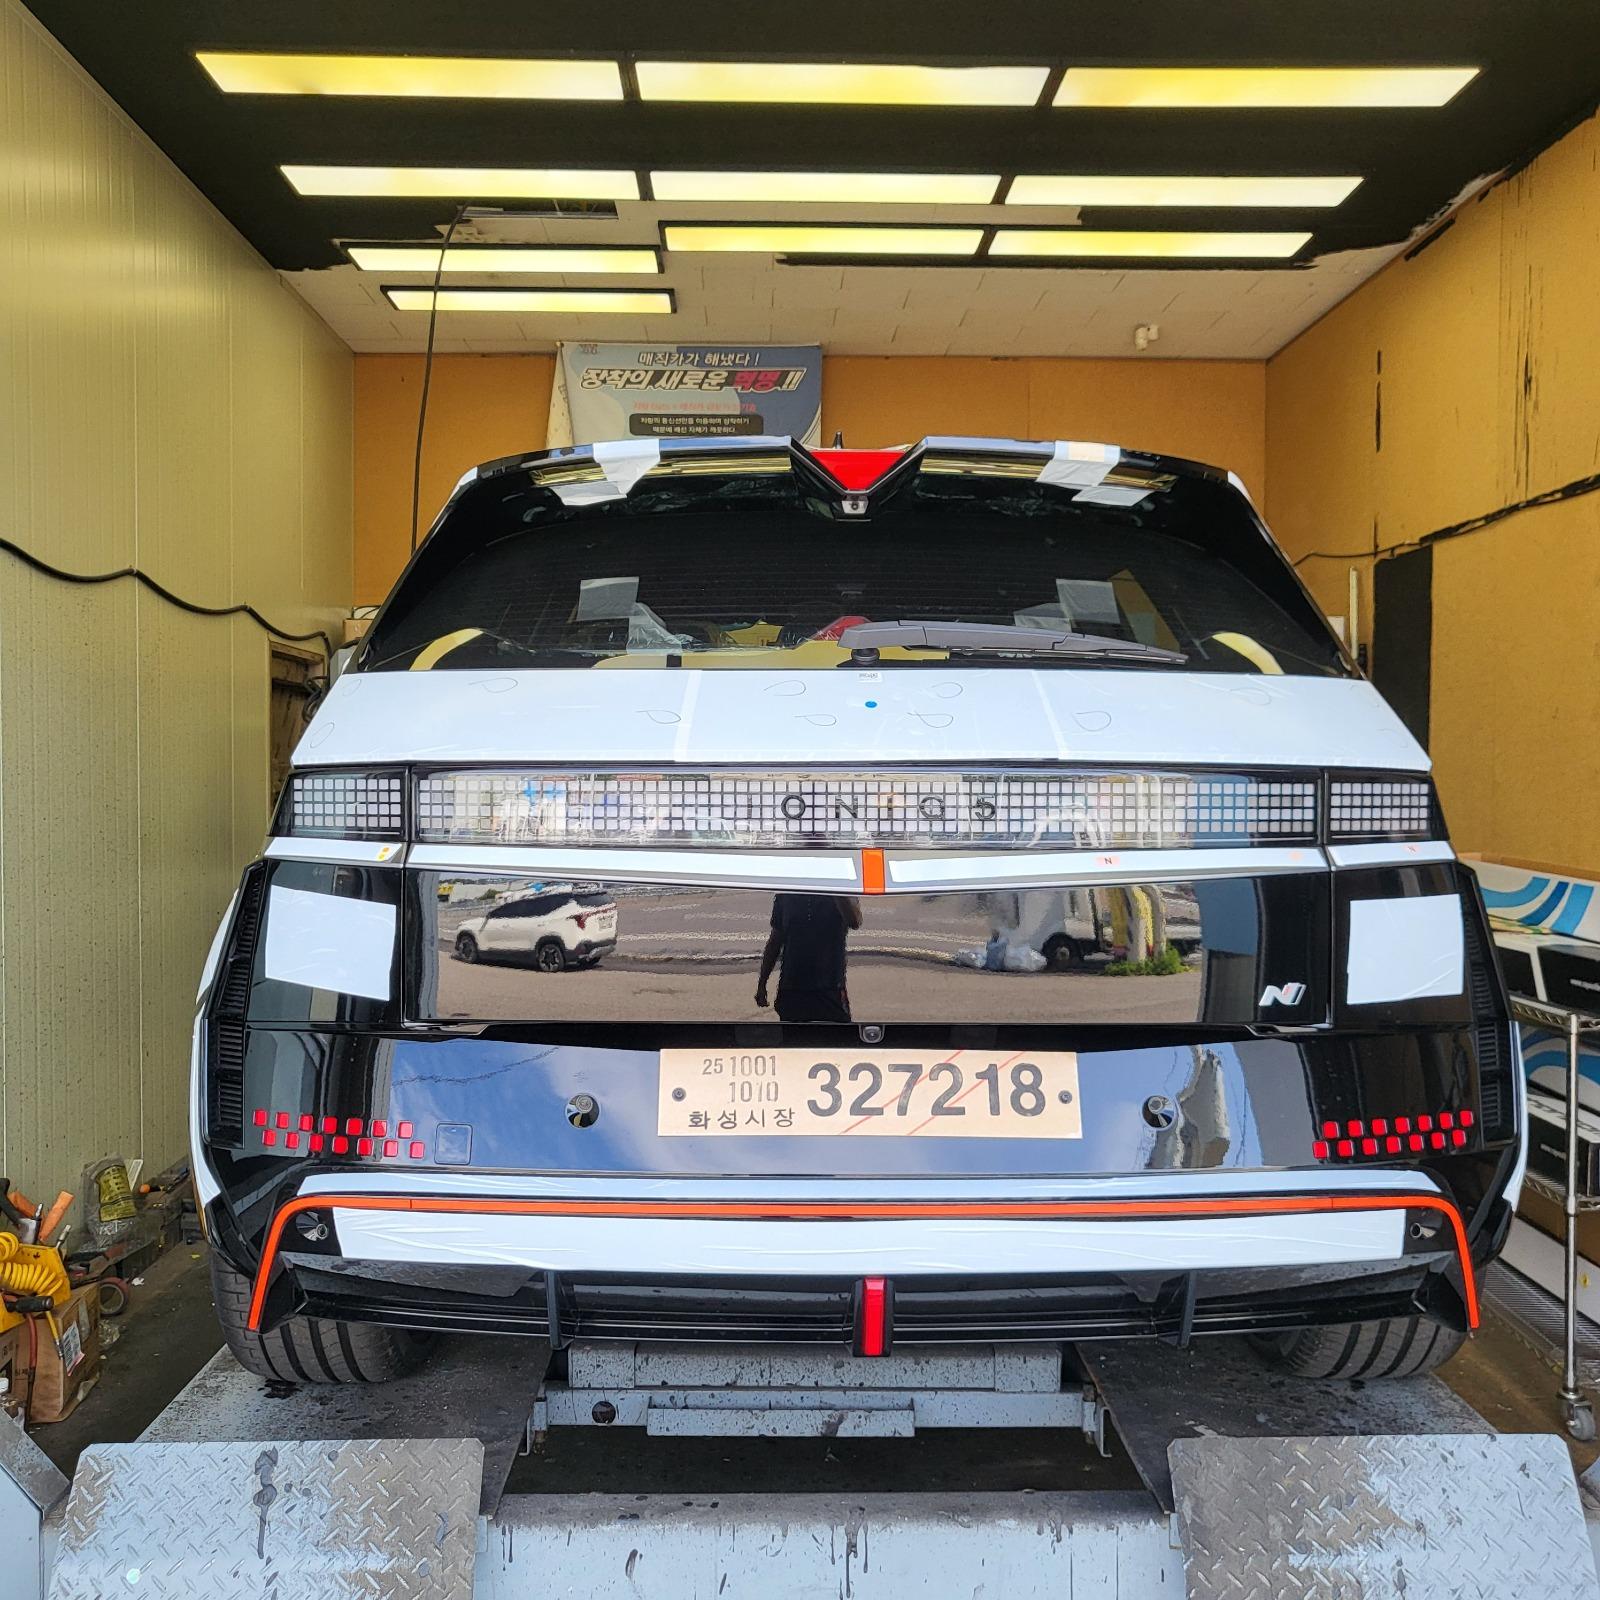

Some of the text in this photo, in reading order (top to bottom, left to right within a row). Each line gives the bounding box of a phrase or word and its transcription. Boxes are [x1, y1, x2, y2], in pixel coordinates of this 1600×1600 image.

[638, 352, 700, 367] 매직카가
[581, 369, 653, 390] 장착의
[654, 369, 729, 390] 새로운
[702, 1055, 776, 1077] 25 1001
[807, 1062, 1047, 1117] 327218
